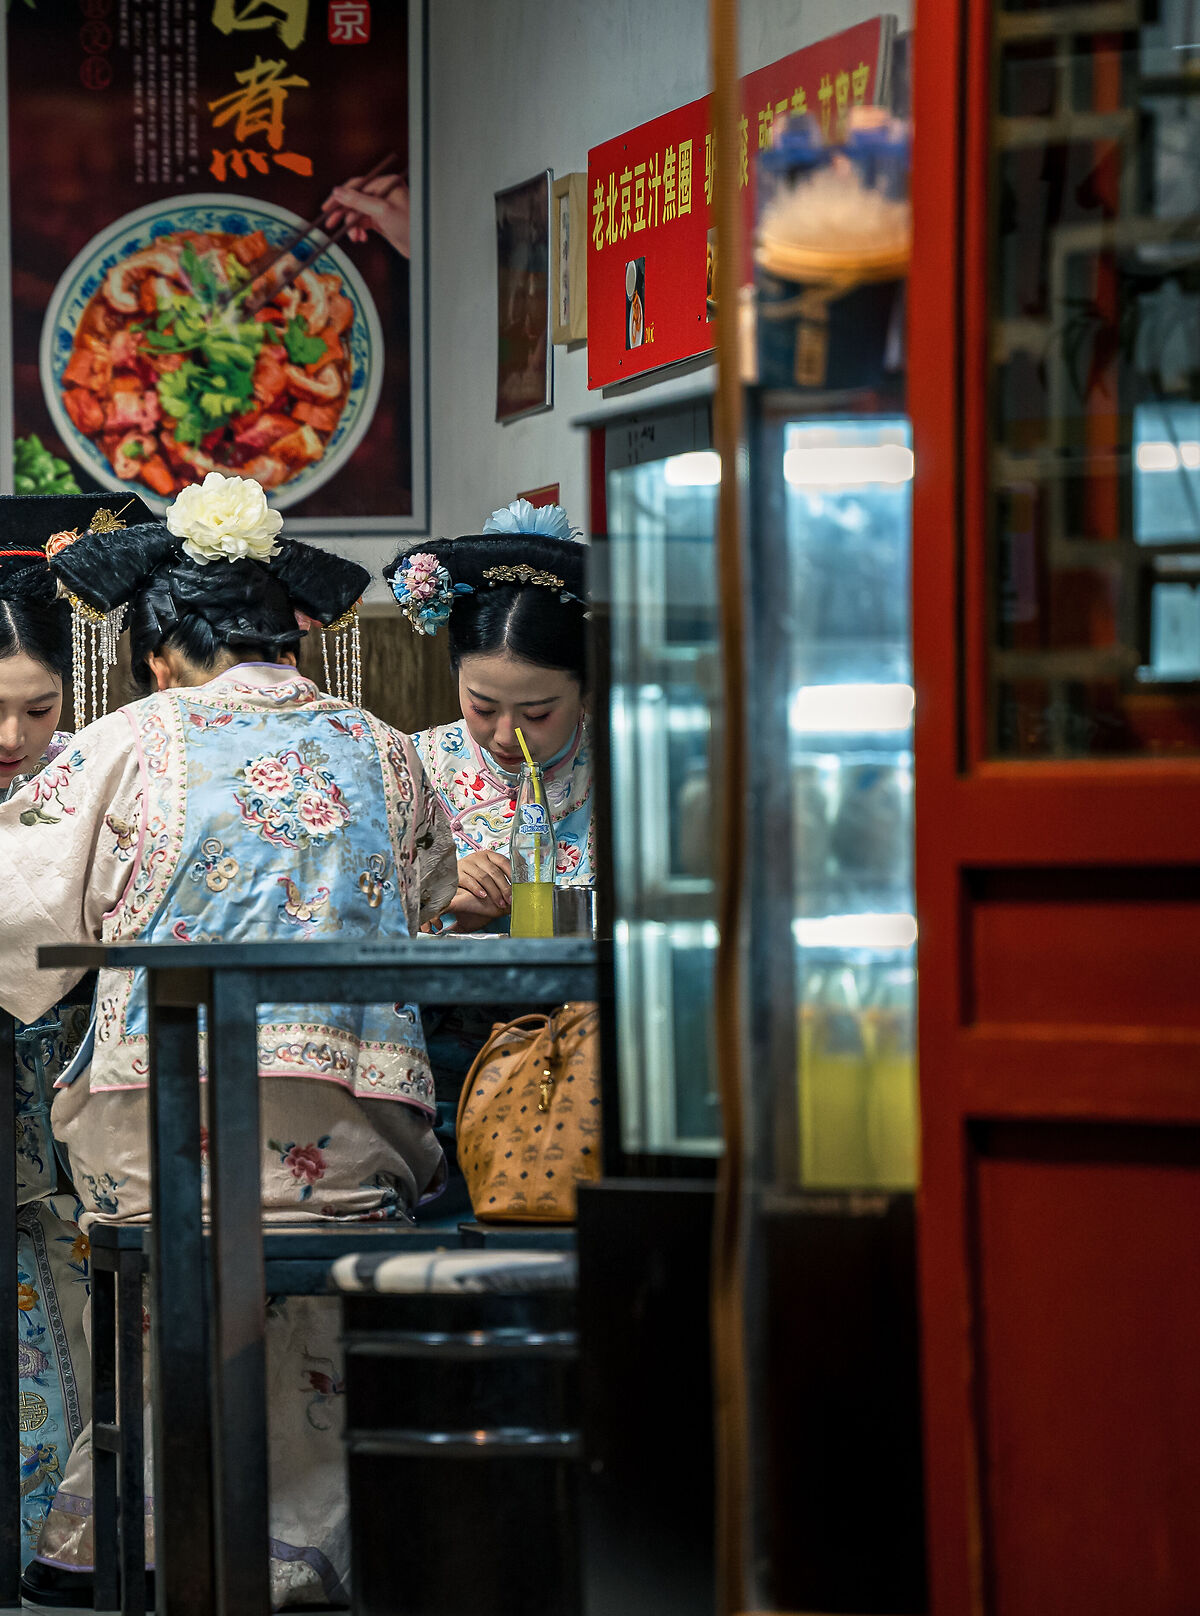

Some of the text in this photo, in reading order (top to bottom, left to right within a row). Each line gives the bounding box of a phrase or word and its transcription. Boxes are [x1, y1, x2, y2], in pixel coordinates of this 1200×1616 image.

[331, 2, 368, 40] 京
[592, 138, 693, 251] 老北京豆汁焦圈
